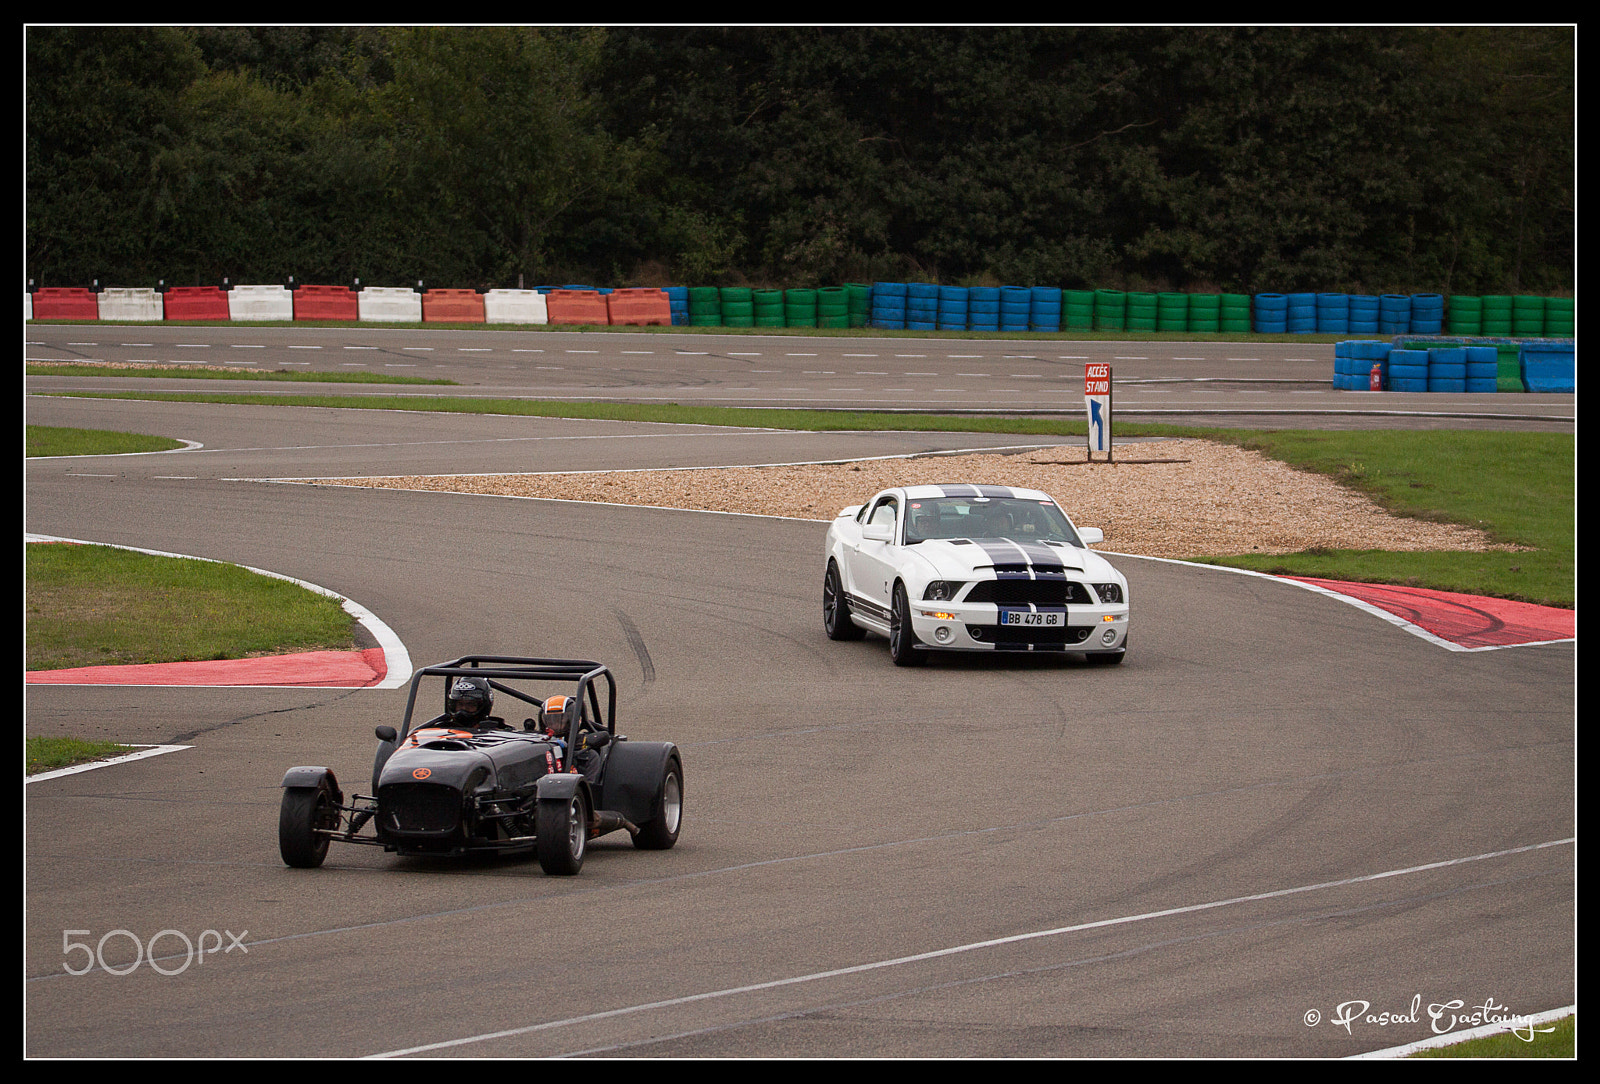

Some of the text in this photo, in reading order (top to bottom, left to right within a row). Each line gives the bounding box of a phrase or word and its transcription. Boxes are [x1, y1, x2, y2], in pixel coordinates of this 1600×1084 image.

[1086, 381, 1109, 392] STAND
[1008, 613, 1058, 625] BB 478 GB
